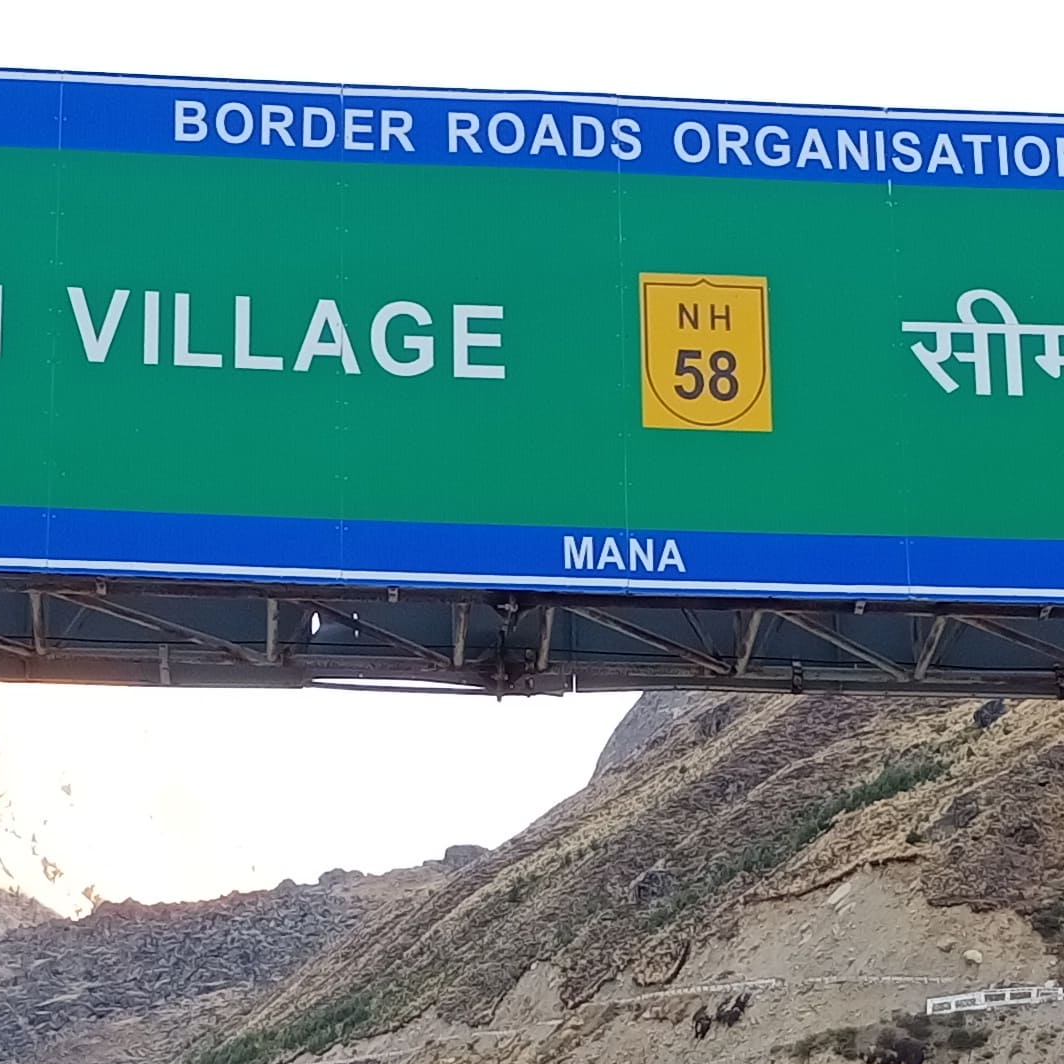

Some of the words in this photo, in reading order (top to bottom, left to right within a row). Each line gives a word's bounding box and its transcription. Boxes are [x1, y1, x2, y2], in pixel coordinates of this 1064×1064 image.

[174, 100, 415, 152] BORDER
[448, 112, 642, 160] ROADS
[674, 121, 1064, 178] ORGANISATIO
[67, 286, 506, 379] VILLAGE
[674, 349, 739, 402] 58
[563, 535, 687, 573] MANA
